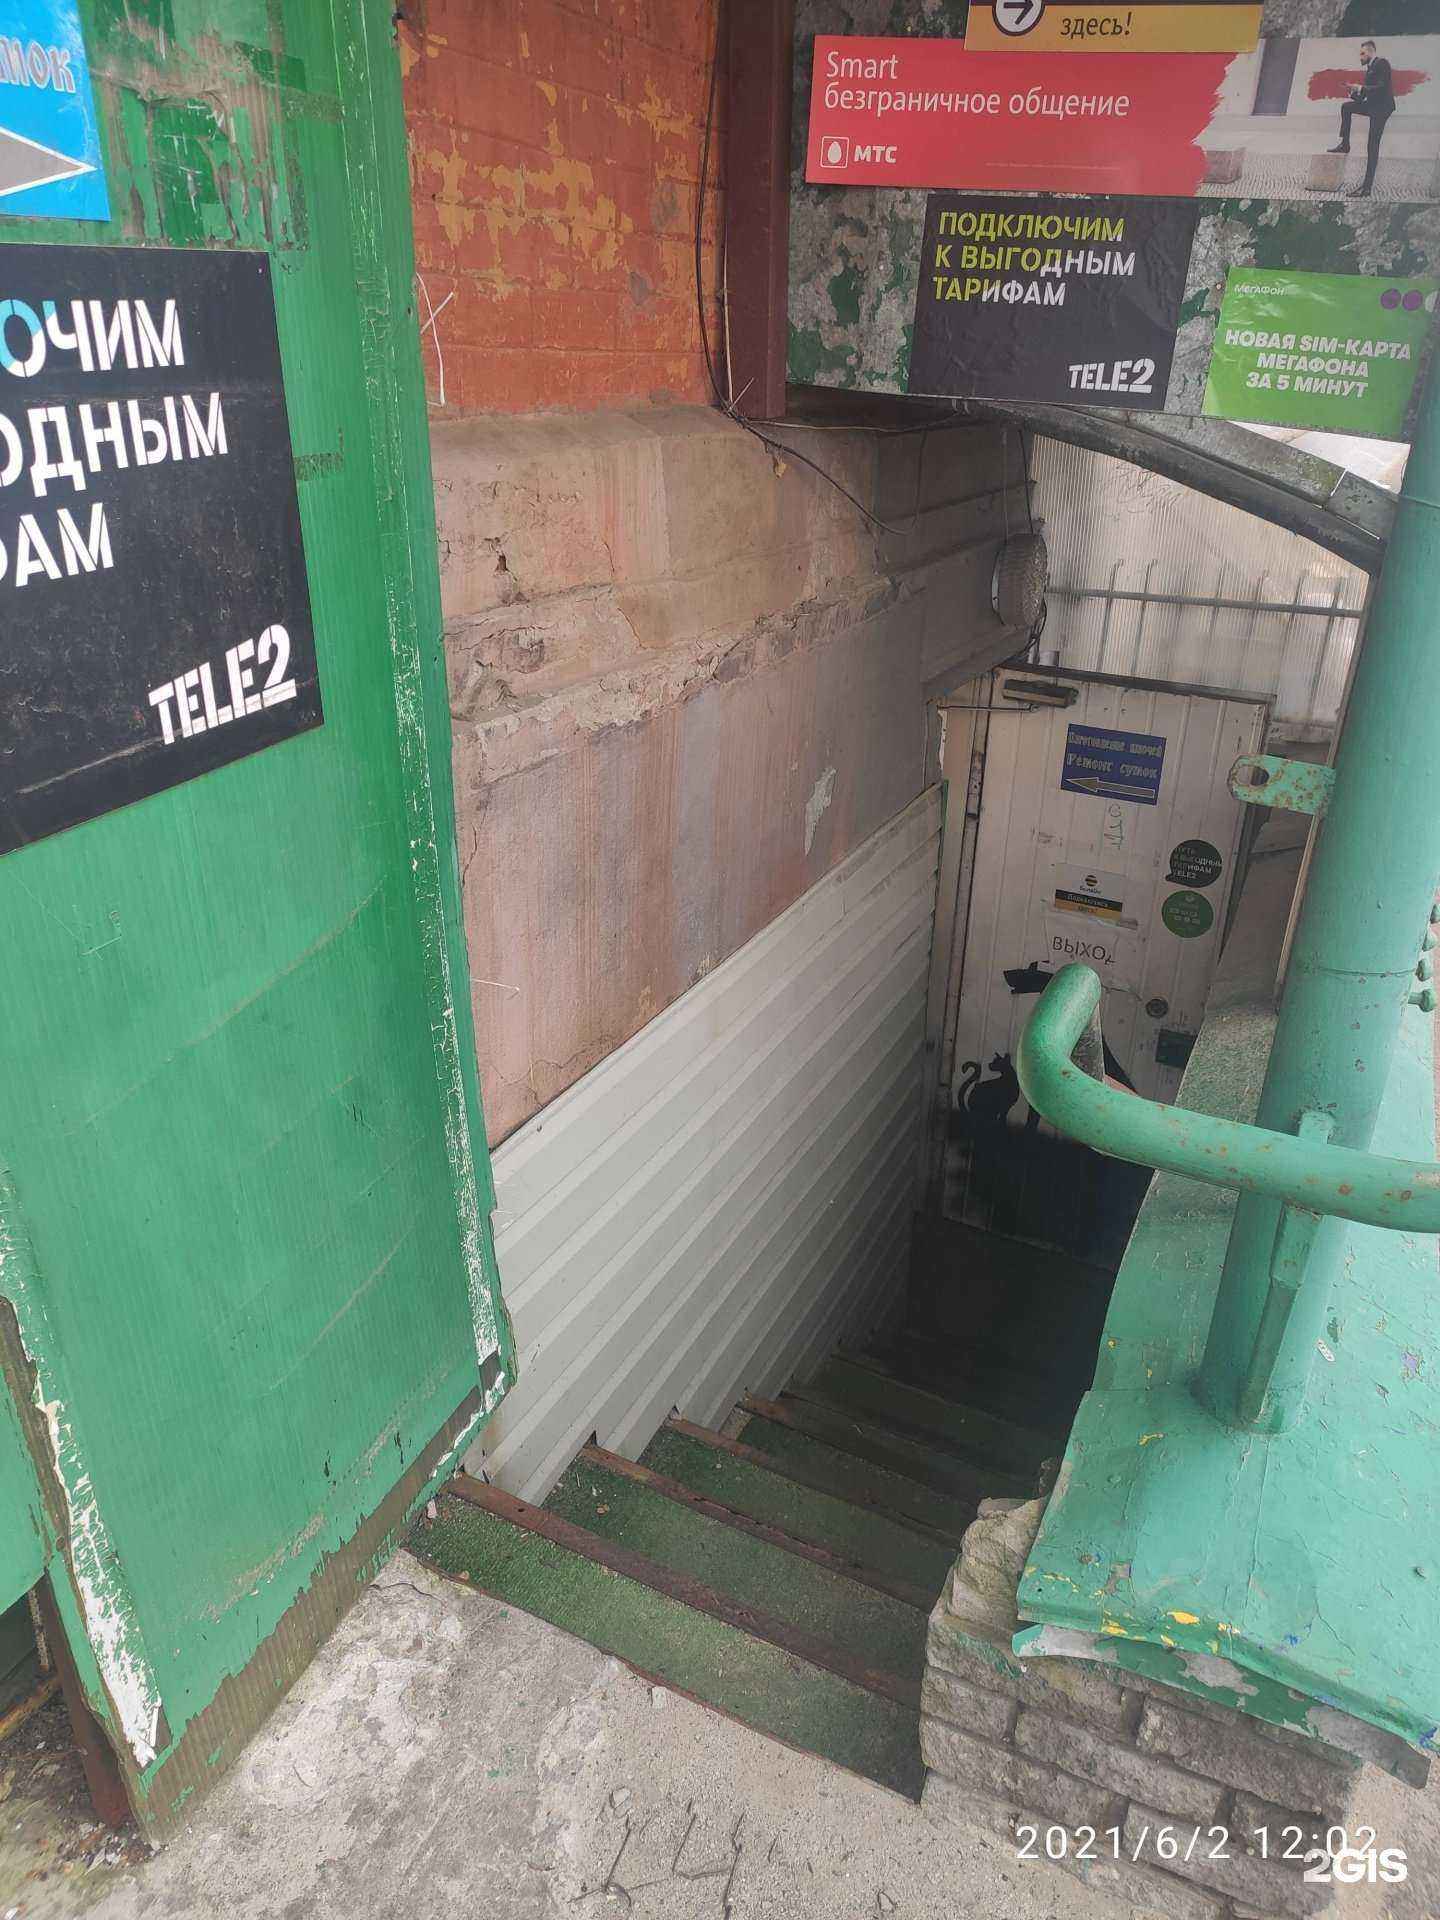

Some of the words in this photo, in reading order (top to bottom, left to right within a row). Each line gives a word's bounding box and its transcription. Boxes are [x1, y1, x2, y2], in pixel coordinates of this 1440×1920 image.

[1060, 12, 1133, 39] здесь!
[826, 51, 899, 79] Smart
[824, 82, 1001, 117] безграничное
[1008, 86, 1130, 120] общение
[854, 145, 897, 163] МТС
[939, 212, 1124, 242] ПОДКЛЮЧИМ
[935, 244, 952, 268] К
[961, 245, 1136, 278] ВЫГОДНЫМ
[933, 277, 1066, 306] ТАРИФАМ
[1225, 329, 1296, 349] НОВАЯ
[1299, 335, 1411, 360] SIM-КАРТА
[1069, 358, 1156, 393] TELE2
[1257, 352, 1369, 378] МЕГАФОНА
[1246, 371, 1271, 390] ЗА
[1277, 374, 1290, 391] 5
[1294, 376, 1368, 398] МИНУТ
[0, 503, 114, 587] АМ
[148, 624, 297, 745] TELE2
